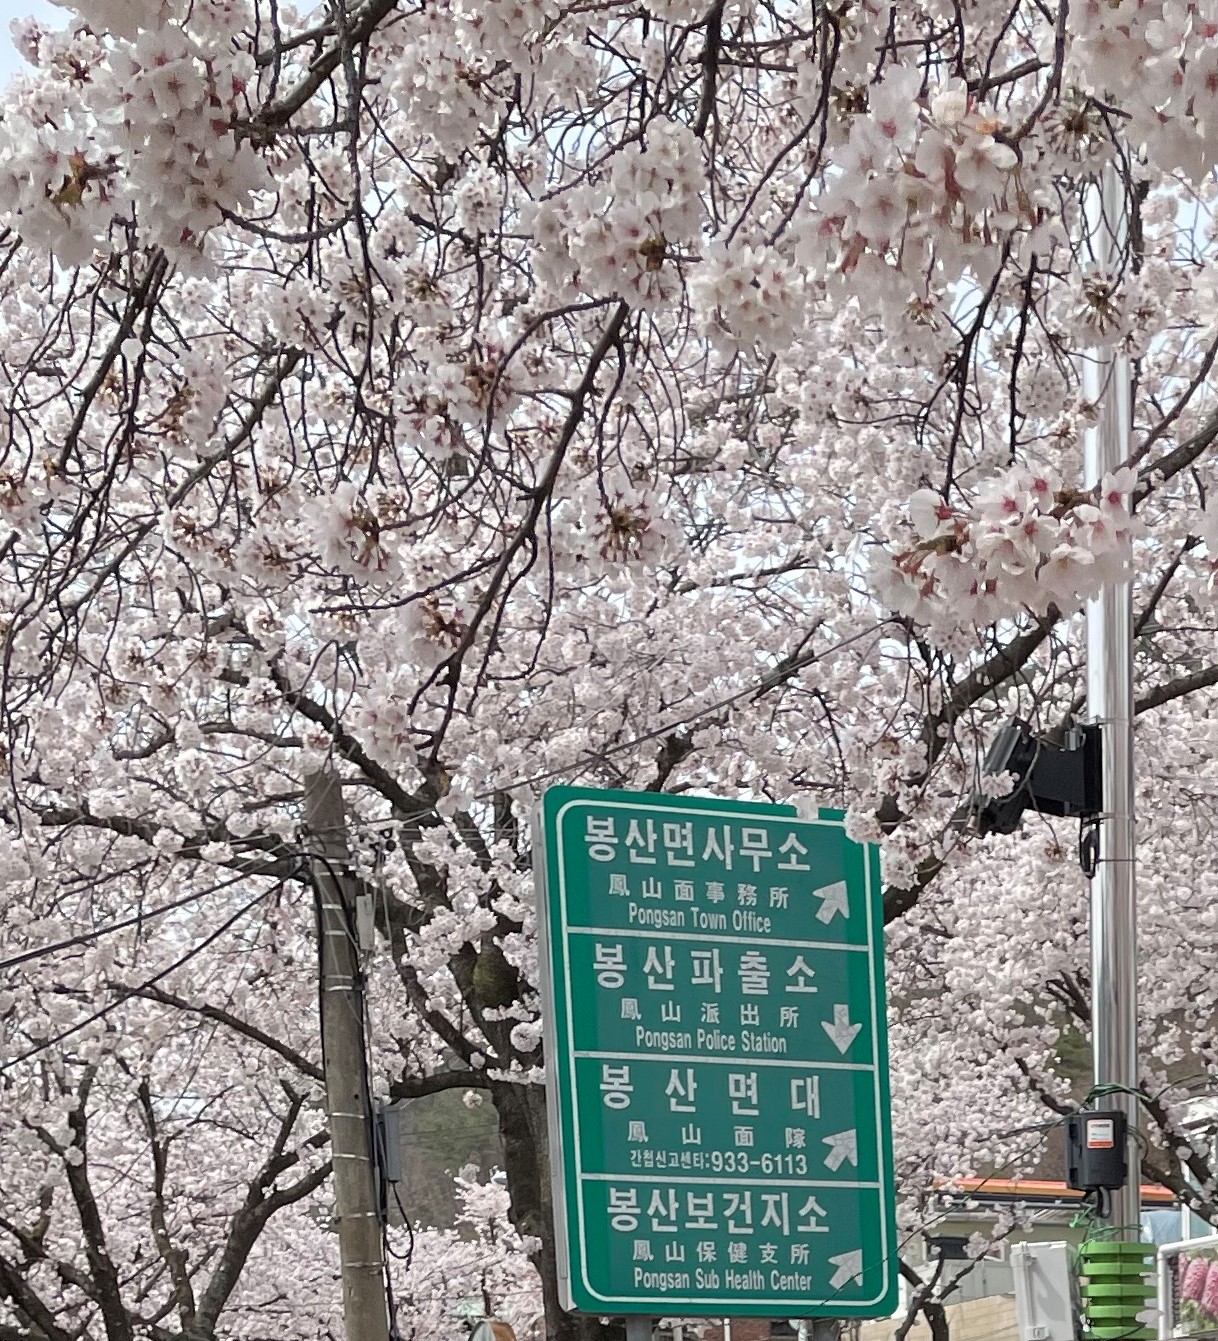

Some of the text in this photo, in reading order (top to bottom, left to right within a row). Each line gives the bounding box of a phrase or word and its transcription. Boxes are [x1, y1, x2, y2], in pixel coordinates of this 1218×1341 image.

[584, 815, 811, 872] 봉산면사무소
[628, 902, 772, 933] Pongsan Town Office
[592, 943, 818, 995] 봉산파출소
[635, 1025, 787, 1053] Pongsan Police Station
[607, 1187, 830, 1236] 봉산보건지소
[634, 1266, 812, 1292] Pongsan Sub Health Center
